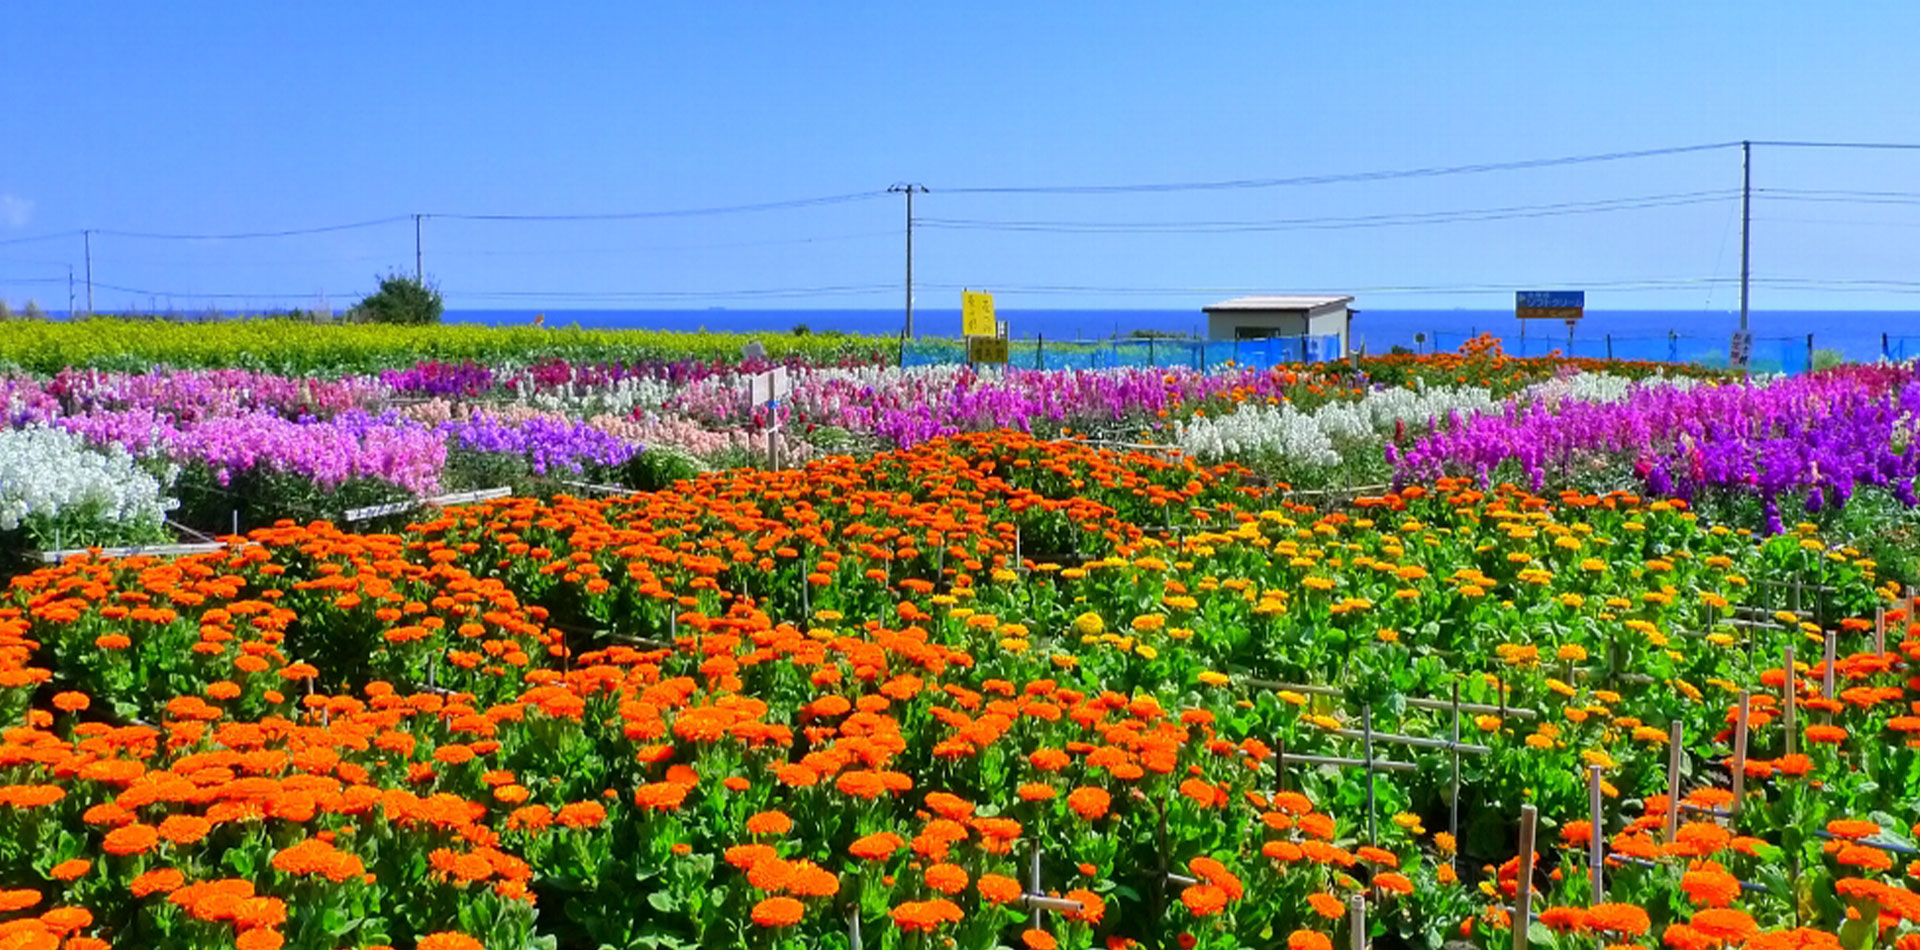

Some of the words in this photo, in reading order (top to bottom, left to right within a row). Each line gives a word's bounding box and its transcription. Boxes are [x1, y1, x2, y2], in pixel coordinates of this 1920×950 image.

[1527, 298, 1582, 307] ソフトクリーム
